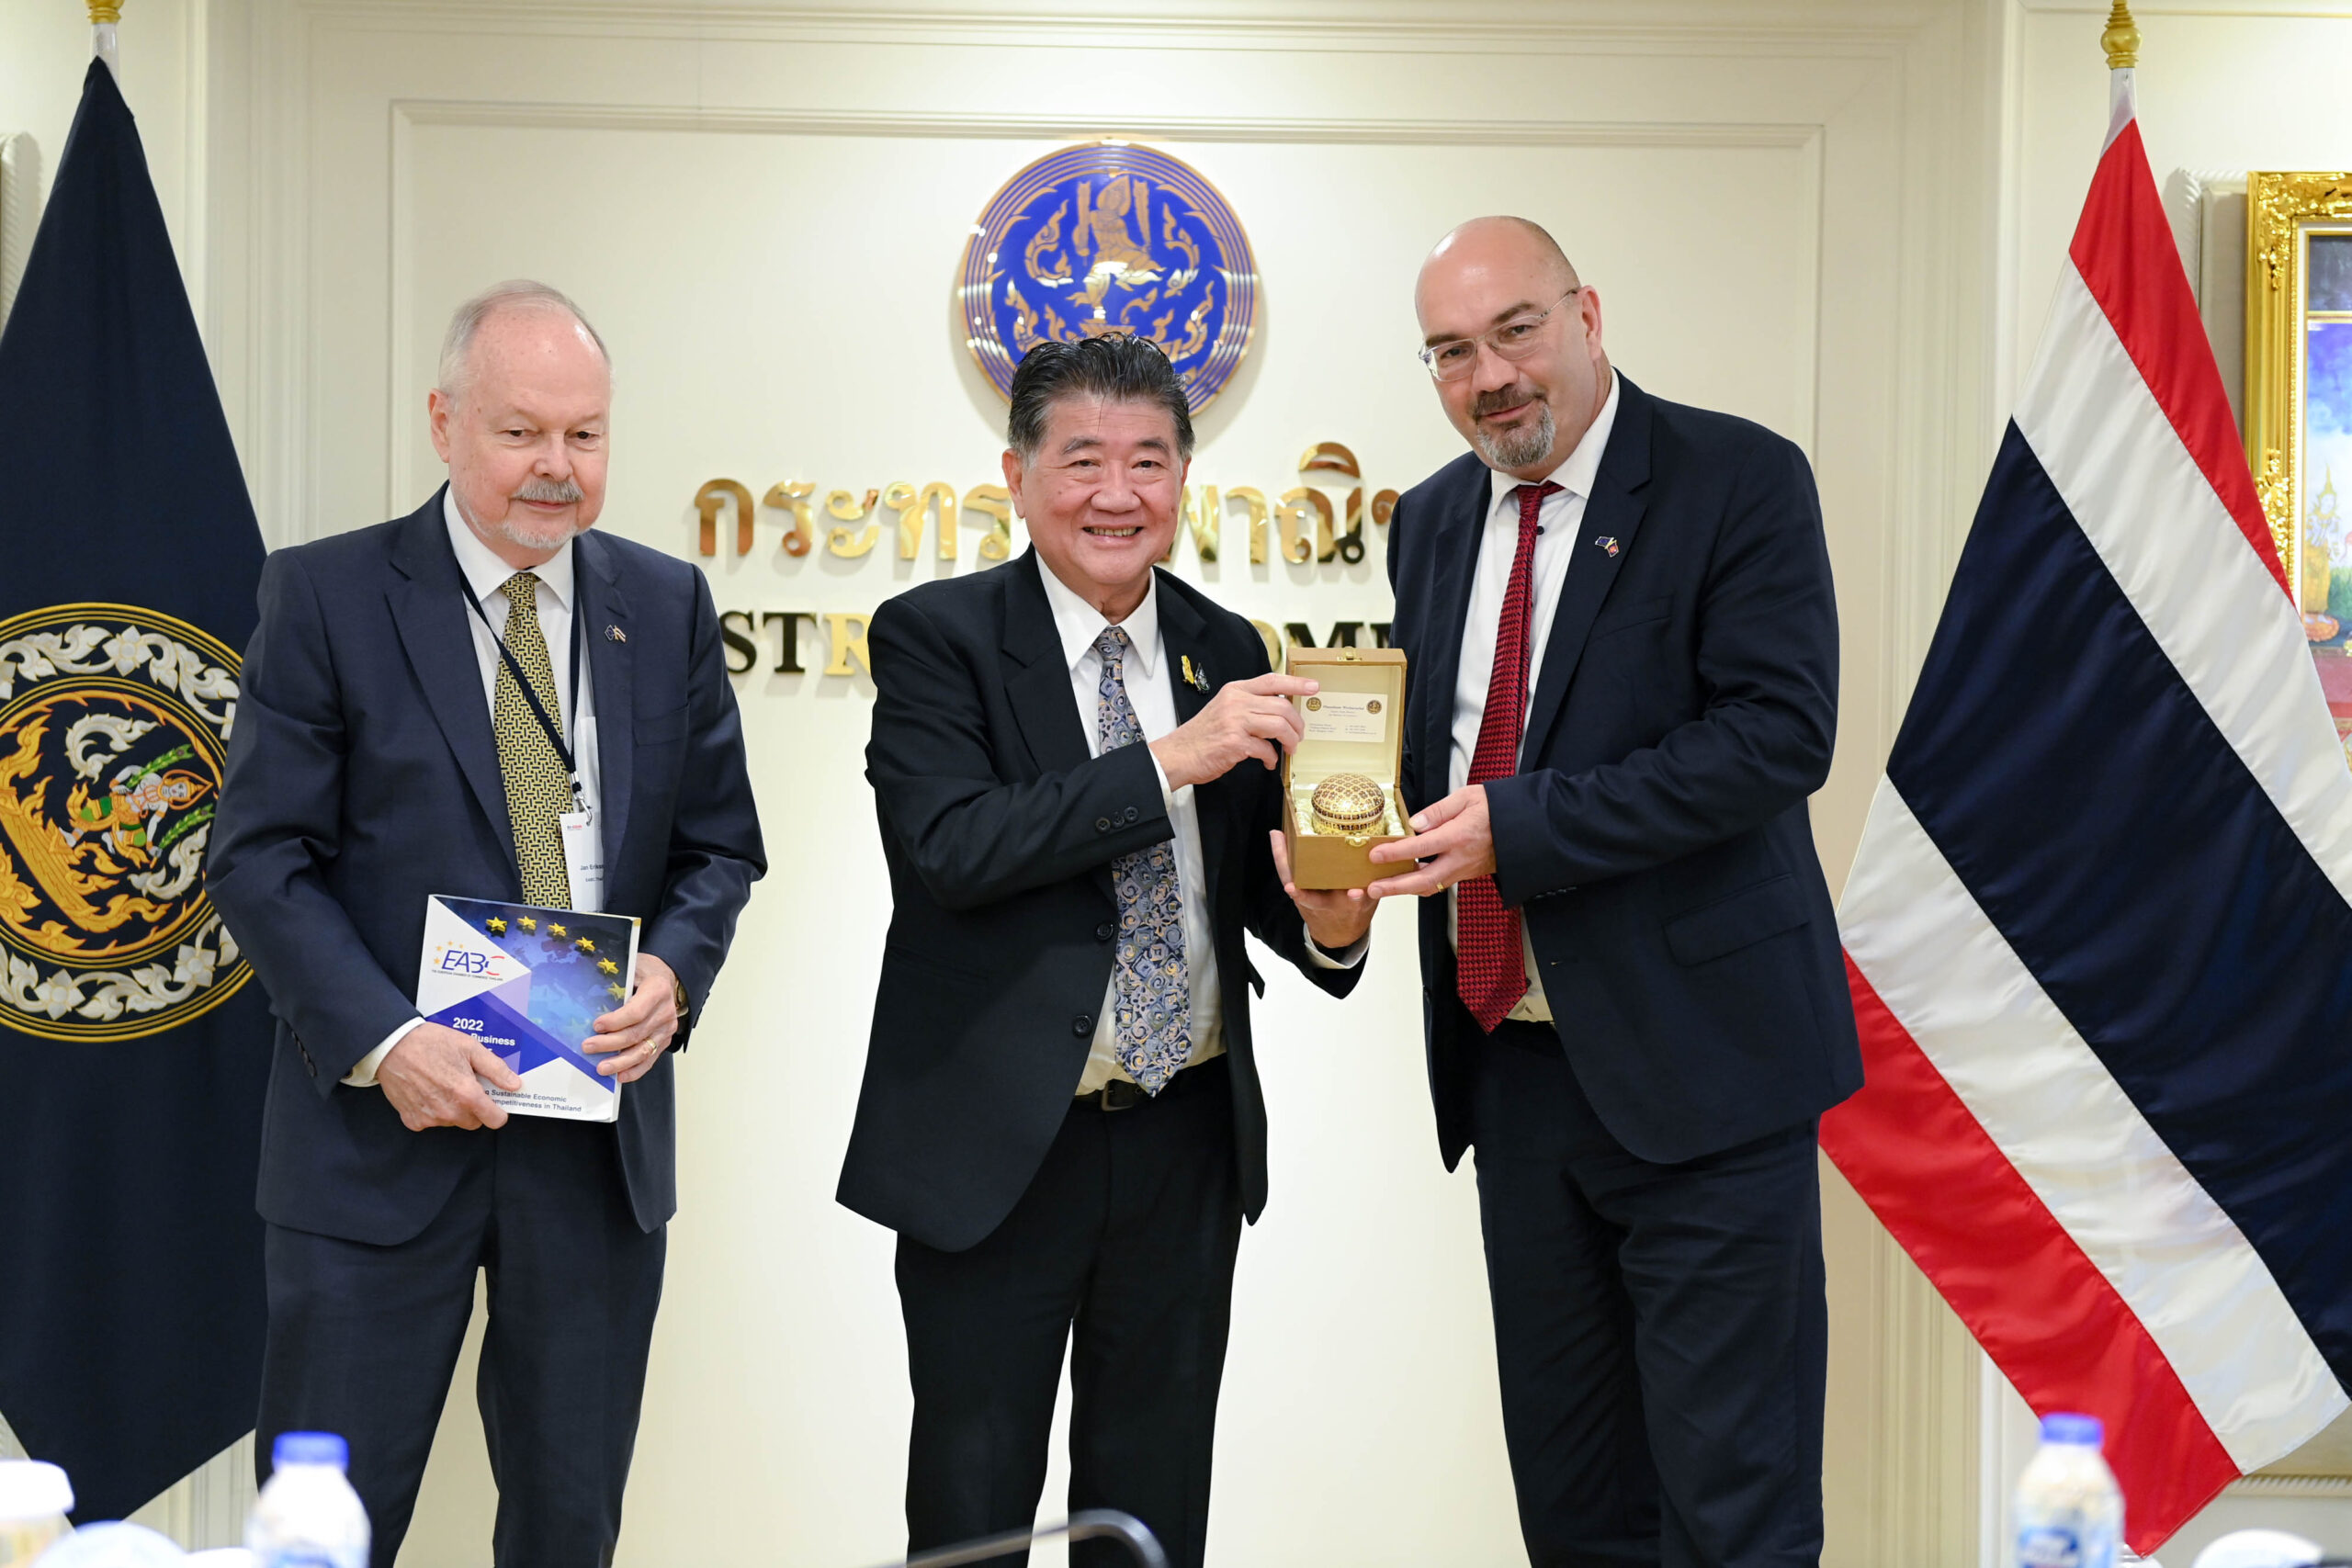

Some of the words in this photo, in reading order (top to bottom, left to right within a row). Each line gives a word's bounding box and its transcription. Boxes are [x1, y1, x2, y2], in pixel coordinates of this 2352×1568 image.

[718, 610, 870, 676] STR
[441, 950, 505, 976] EABC
[453, 1017, 483, 1032] 2022
[492, 1089, 531, 1099] Sustainable
[533, 1093, 567, 1102] Economic
[492, 1099, 542, 1109] mpetitiveness
[553, 1103, 582, 1112] Thailand
